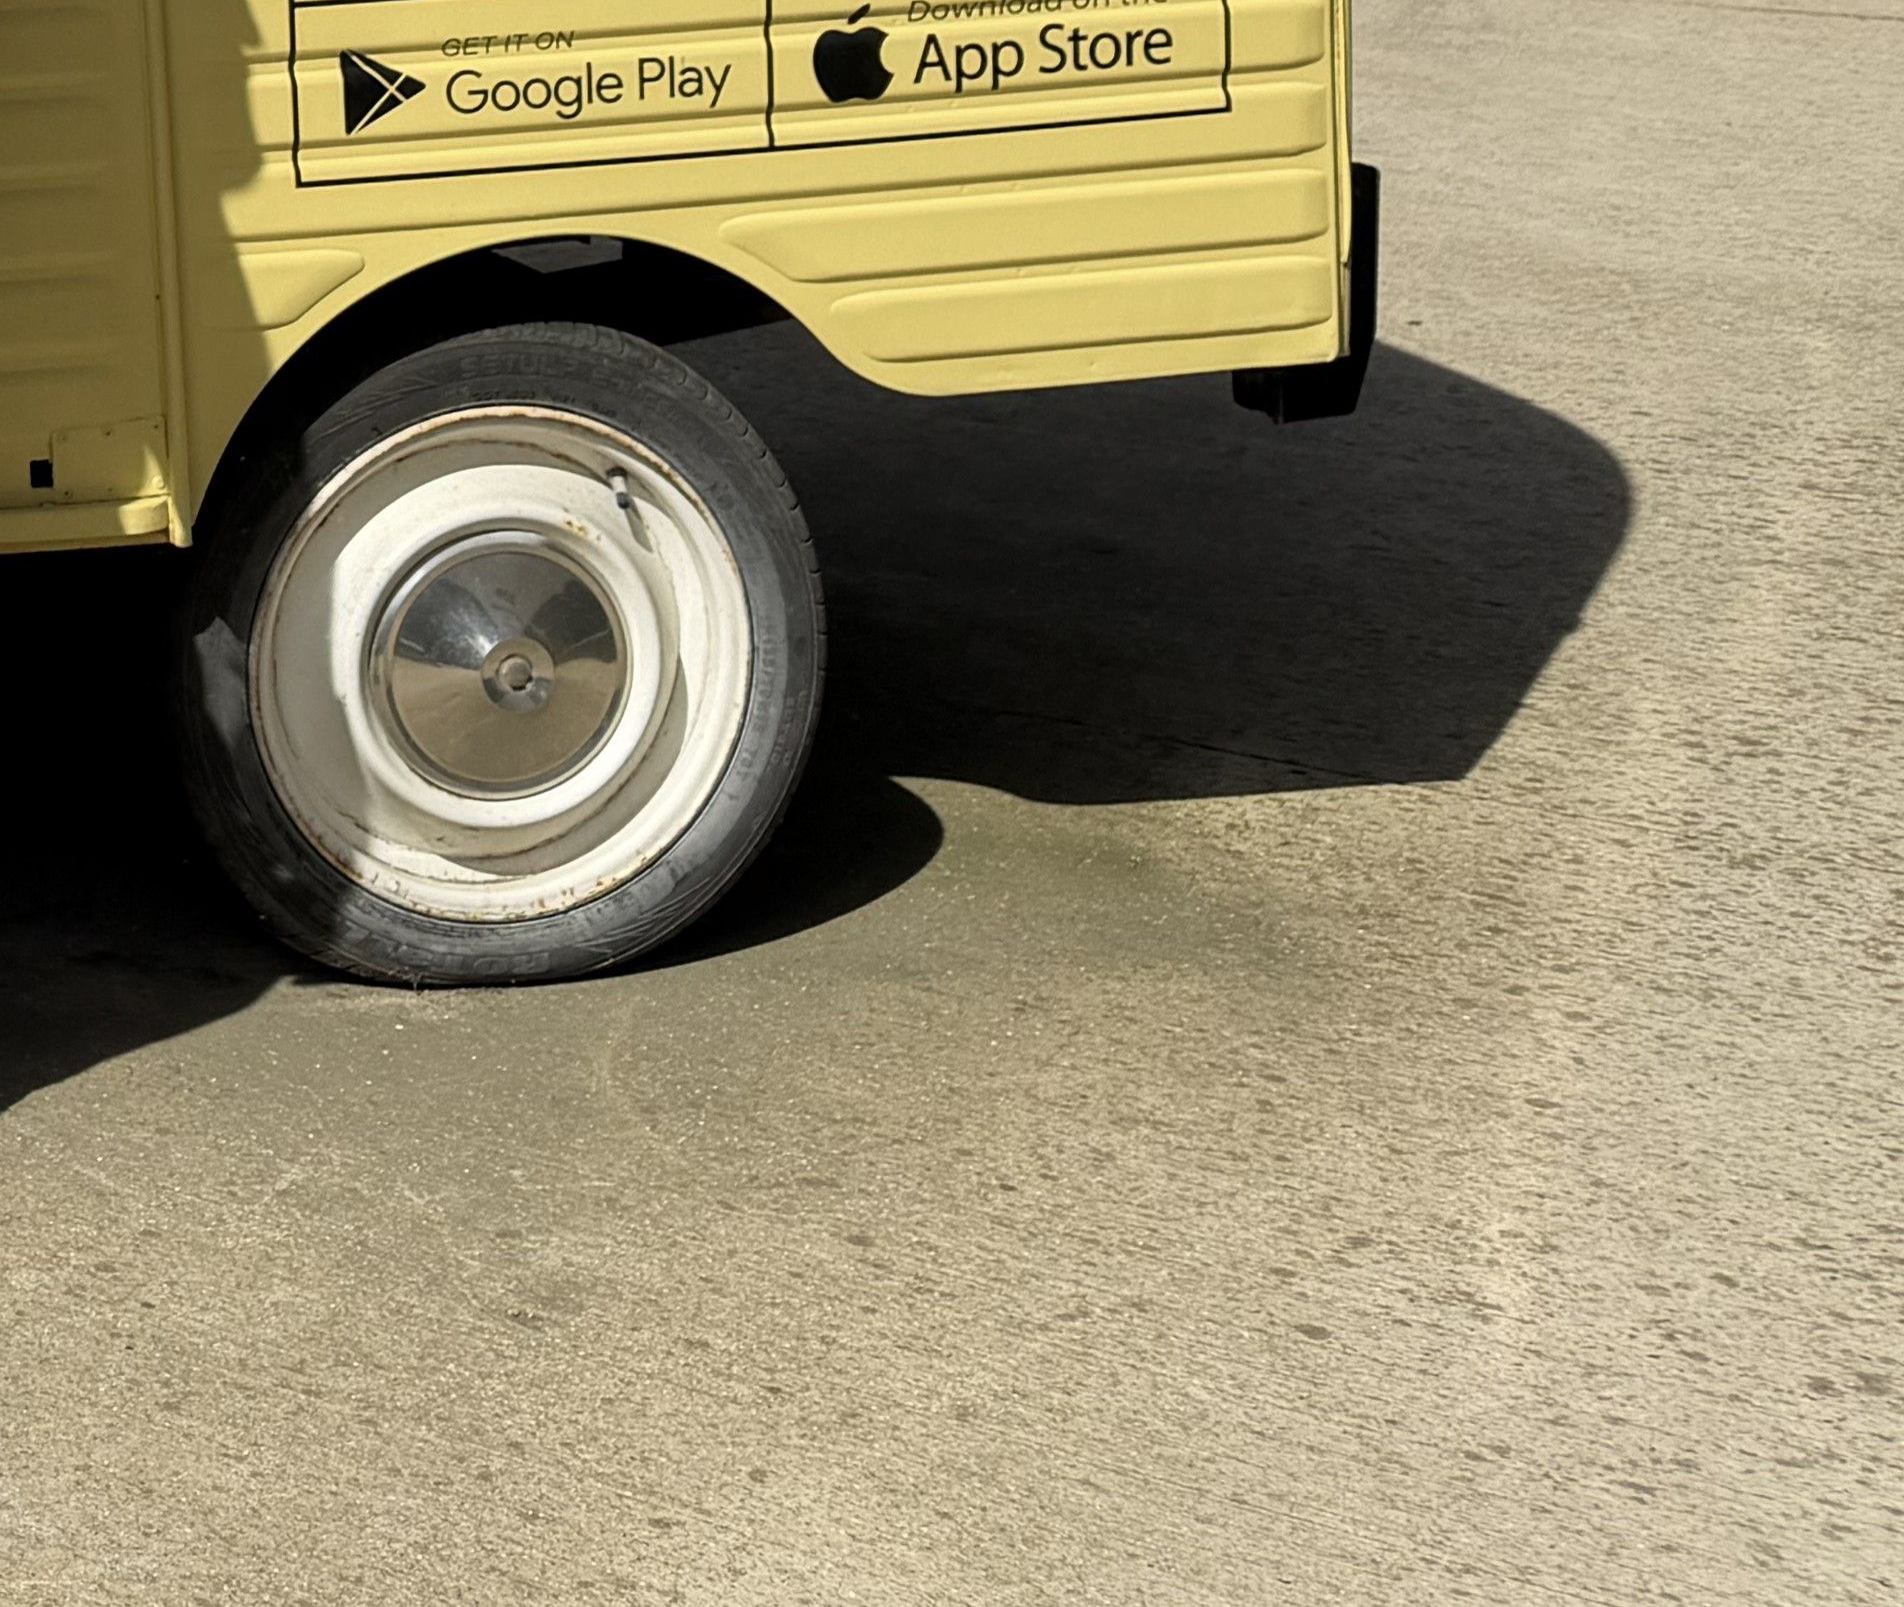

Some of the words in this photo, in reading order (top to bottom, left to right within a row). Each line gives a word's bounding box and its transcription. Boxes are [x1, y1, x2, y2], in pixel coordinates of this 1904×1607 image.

[441, 35, 498, 58] GET
[503, 33, 530, 54] IT
[534, 30, 576, 51] ON
[913, 33, 1025, 93] App
[1038, 23, 1174, 74] Store
[445, 68, 624, 120] Google
[638, 55, 732, 109] Play
